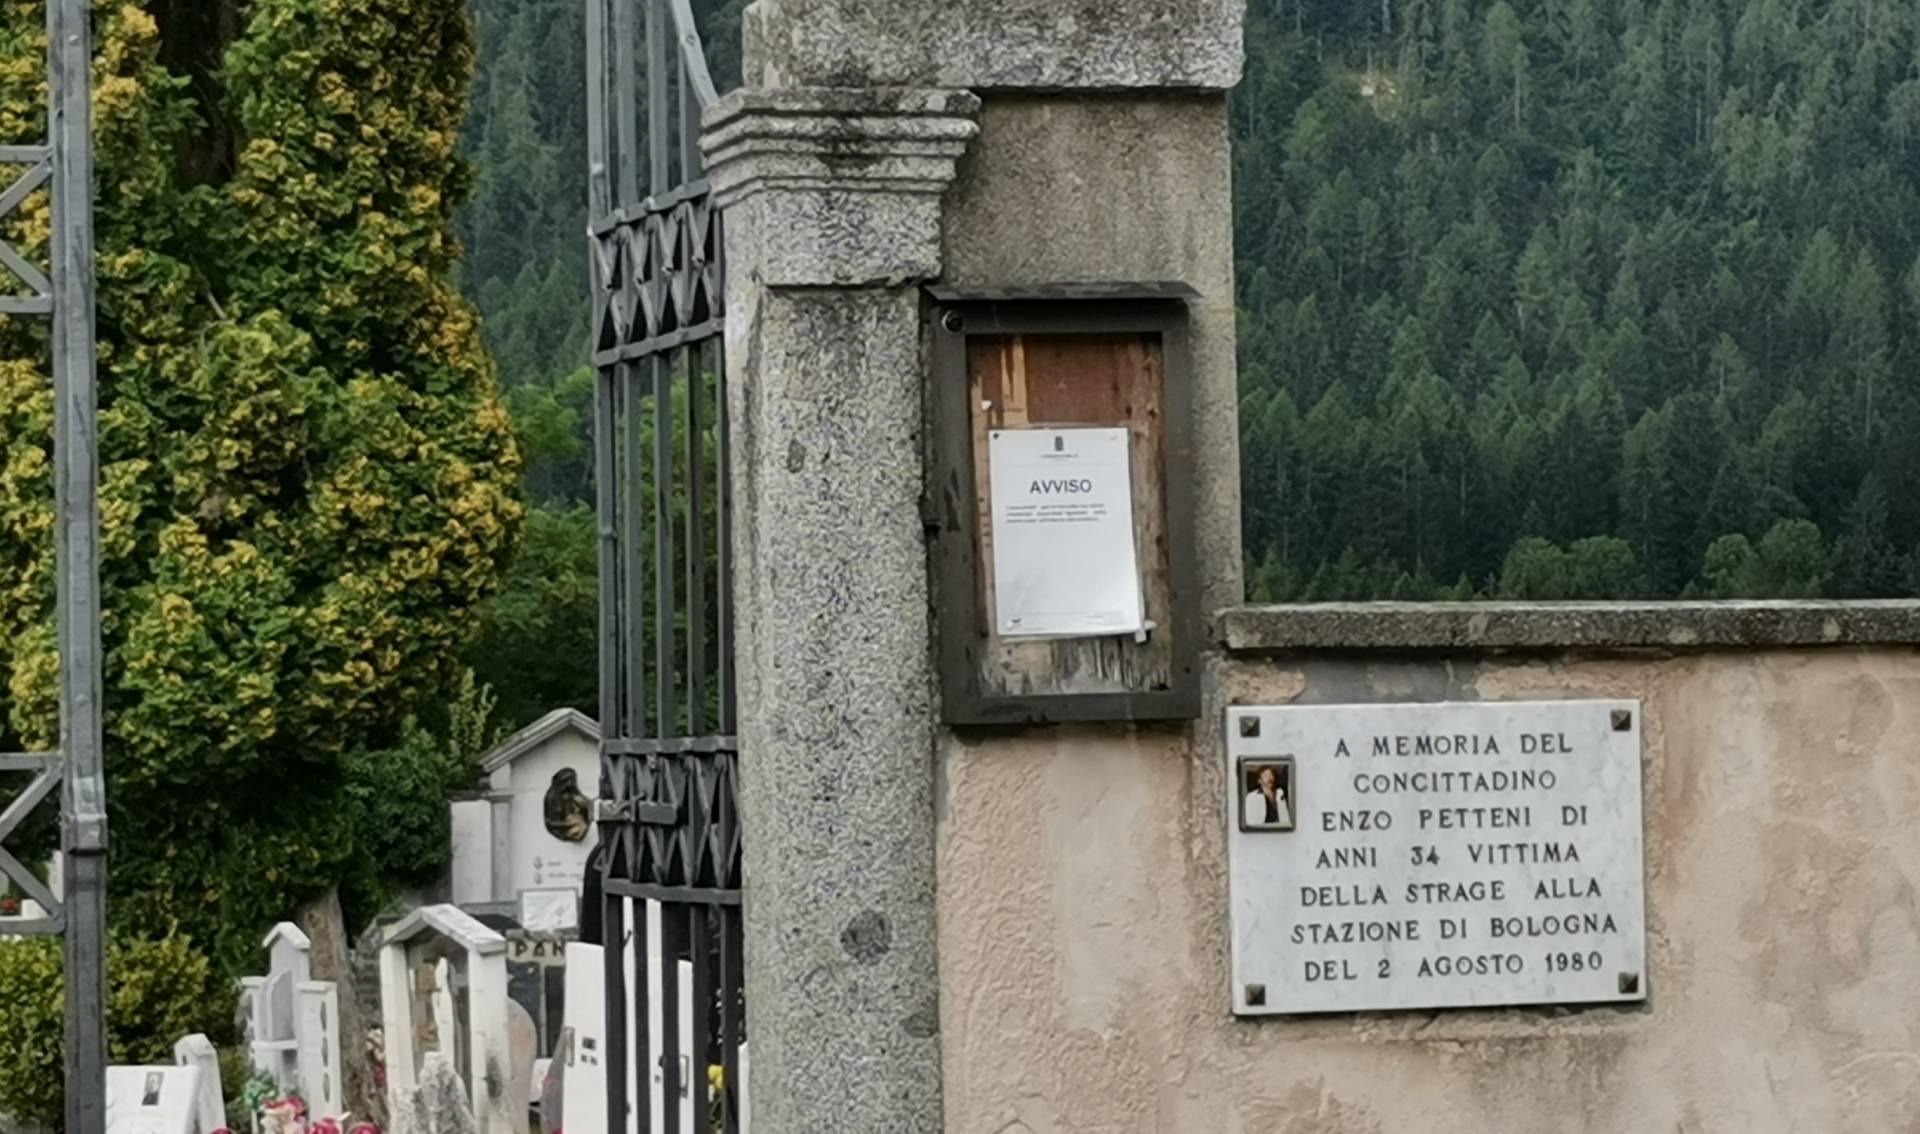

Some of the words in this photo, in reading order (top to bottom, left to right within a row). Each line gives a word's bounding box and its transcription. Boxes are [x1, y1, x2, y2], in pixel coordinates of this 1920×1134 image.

[1030, 479, 1092, 494] AVVISO
[1334, 738, 1350, 757] A
[1372, 735, 1500, 757] MEMORIA
[1520, 733, 1573, 754] DEL
[1353, 770, 1556, 794] CONCITTADINO
[1321, 810, 1392, 832] ENZO
[1419, 806, 1531, 829] PETTENI
[1561, 805, 1588, 826] DI
[1316, 847, 1377, 869] ANNI
[1410, 846, 1440, 866] 34
[1467, 843, 1580, 864] VITTIMA
[1301, 885, 1388, 907] DELLA
[1405, 881, 1505, 903] STRAGE
[1534, 877, 1602, 899] ALLA
[1291, 920, 1420, 944] STAZIONE
[1440, 918, 1467, 939] DI
[1490, 914, 1618, 938] BOLOGNA
[1304, 961, 1357, 982] DEL
[1377, 959, 1391, 979] 2
[1417, 954, 1524, 978] AGOSTO
[1545, 951, 1603, 973] 1980
